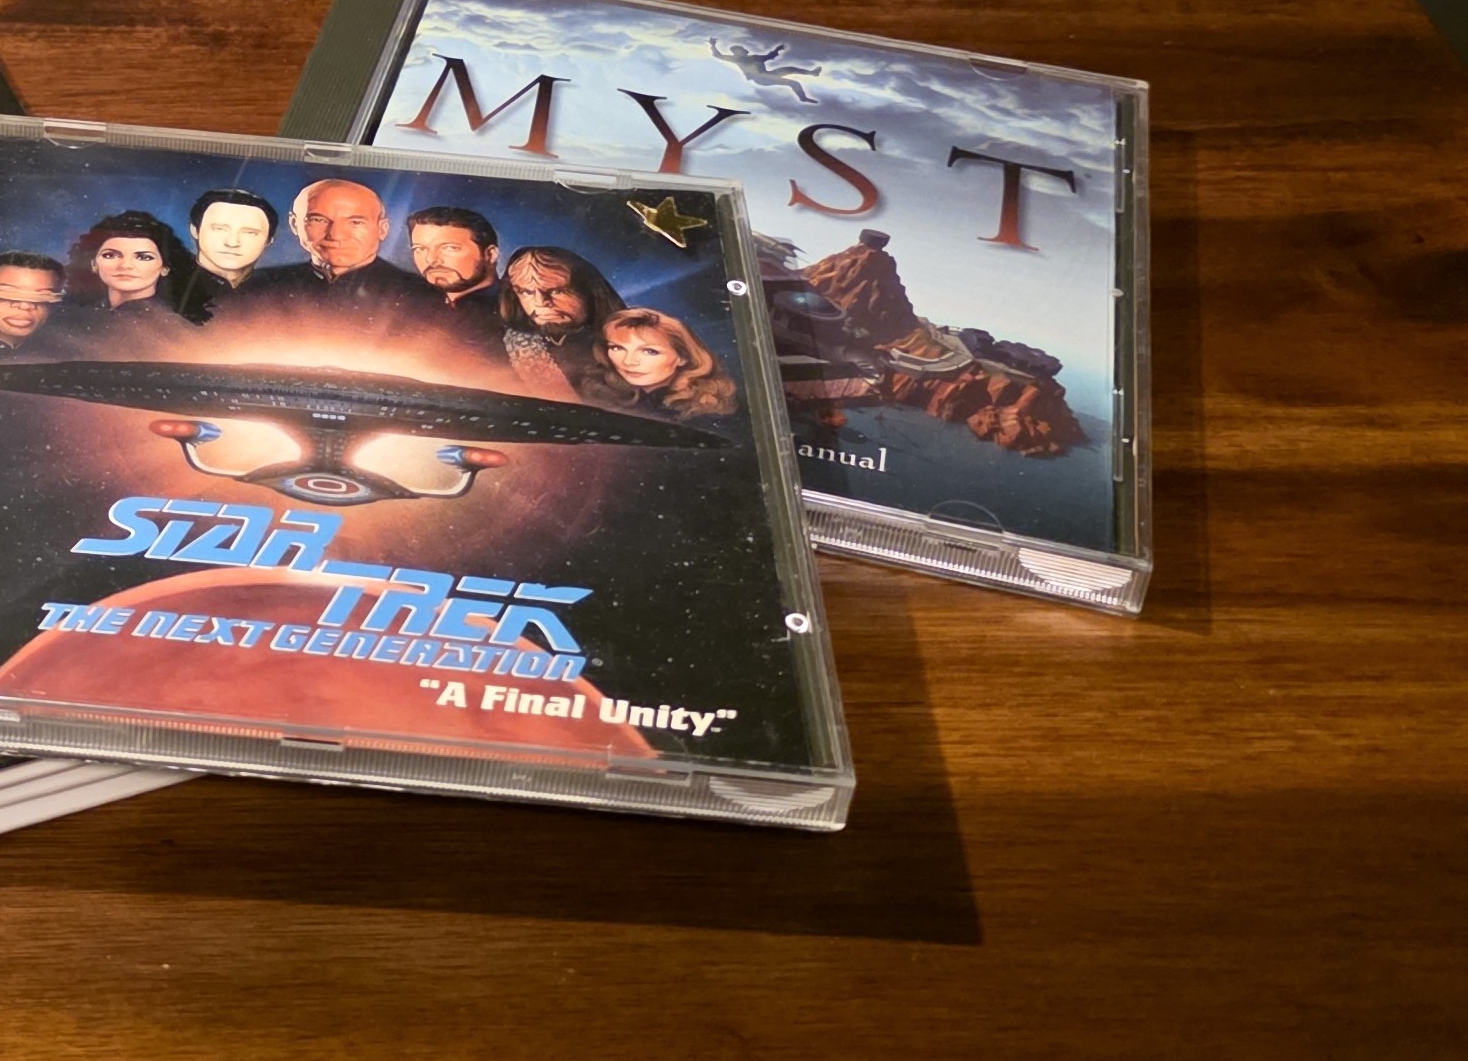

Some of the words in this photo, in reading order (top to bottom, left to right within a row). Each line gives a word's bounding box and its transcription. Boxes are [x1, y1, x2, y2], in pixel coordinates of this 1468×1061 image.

[395, 52, 1076, 255] MYST
[790, 433, 887, 473] anual
[70, 496, 345, 573] STAR
[38, 601, 135, 636] THE
[132, 610, 275, 649] NEXT
[267, 623, 588, 683] GENERATION
[316, 558, 595, 655] TREK
[481, 686, 588, 720] Final
